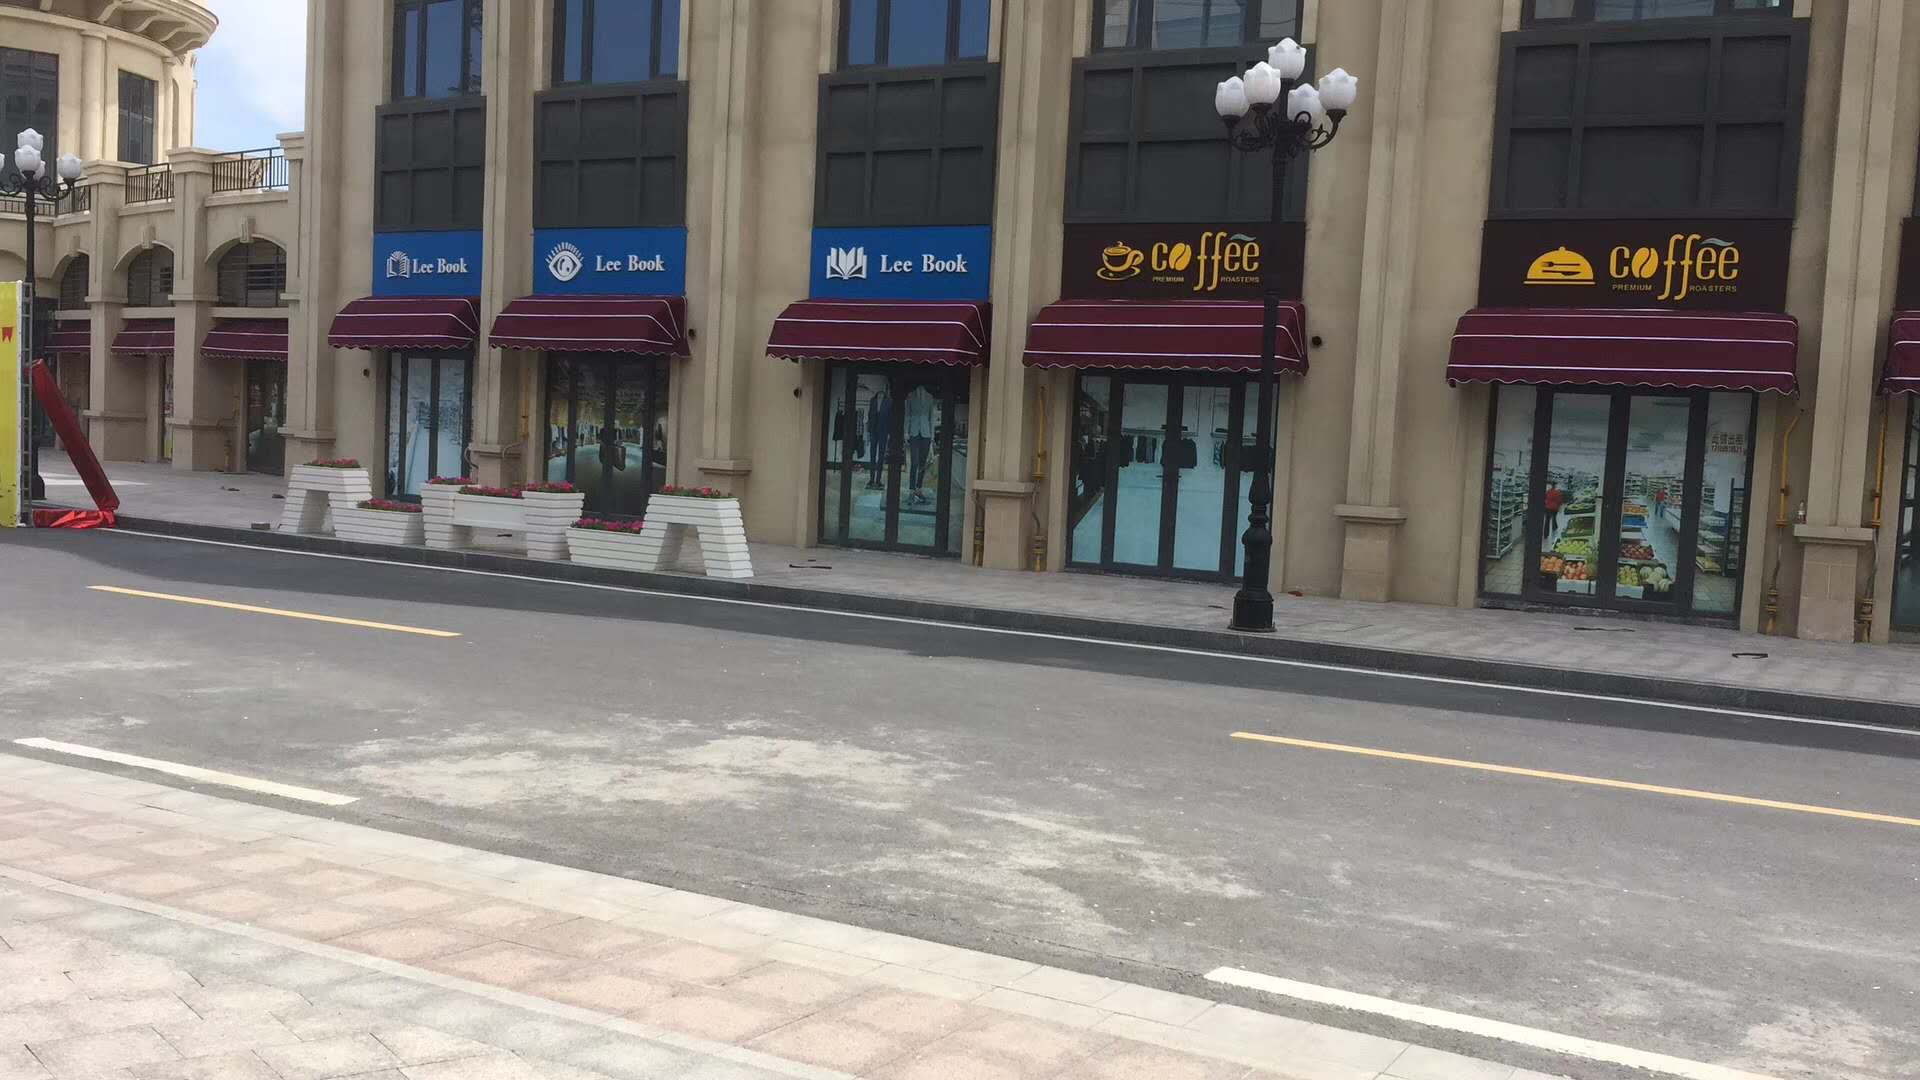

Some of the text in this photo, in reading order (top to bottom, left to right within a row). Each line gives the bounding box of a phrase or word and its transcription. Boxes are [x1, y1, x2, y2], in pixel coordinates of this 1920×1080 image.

[412, 257, 468, 273] Lee Book
[595, 254, 666, 272] Lee Book
[879, 253, 968, 273] Lee Book
[1612, 284, 1737, 293] PREMIUM ROASTERS
